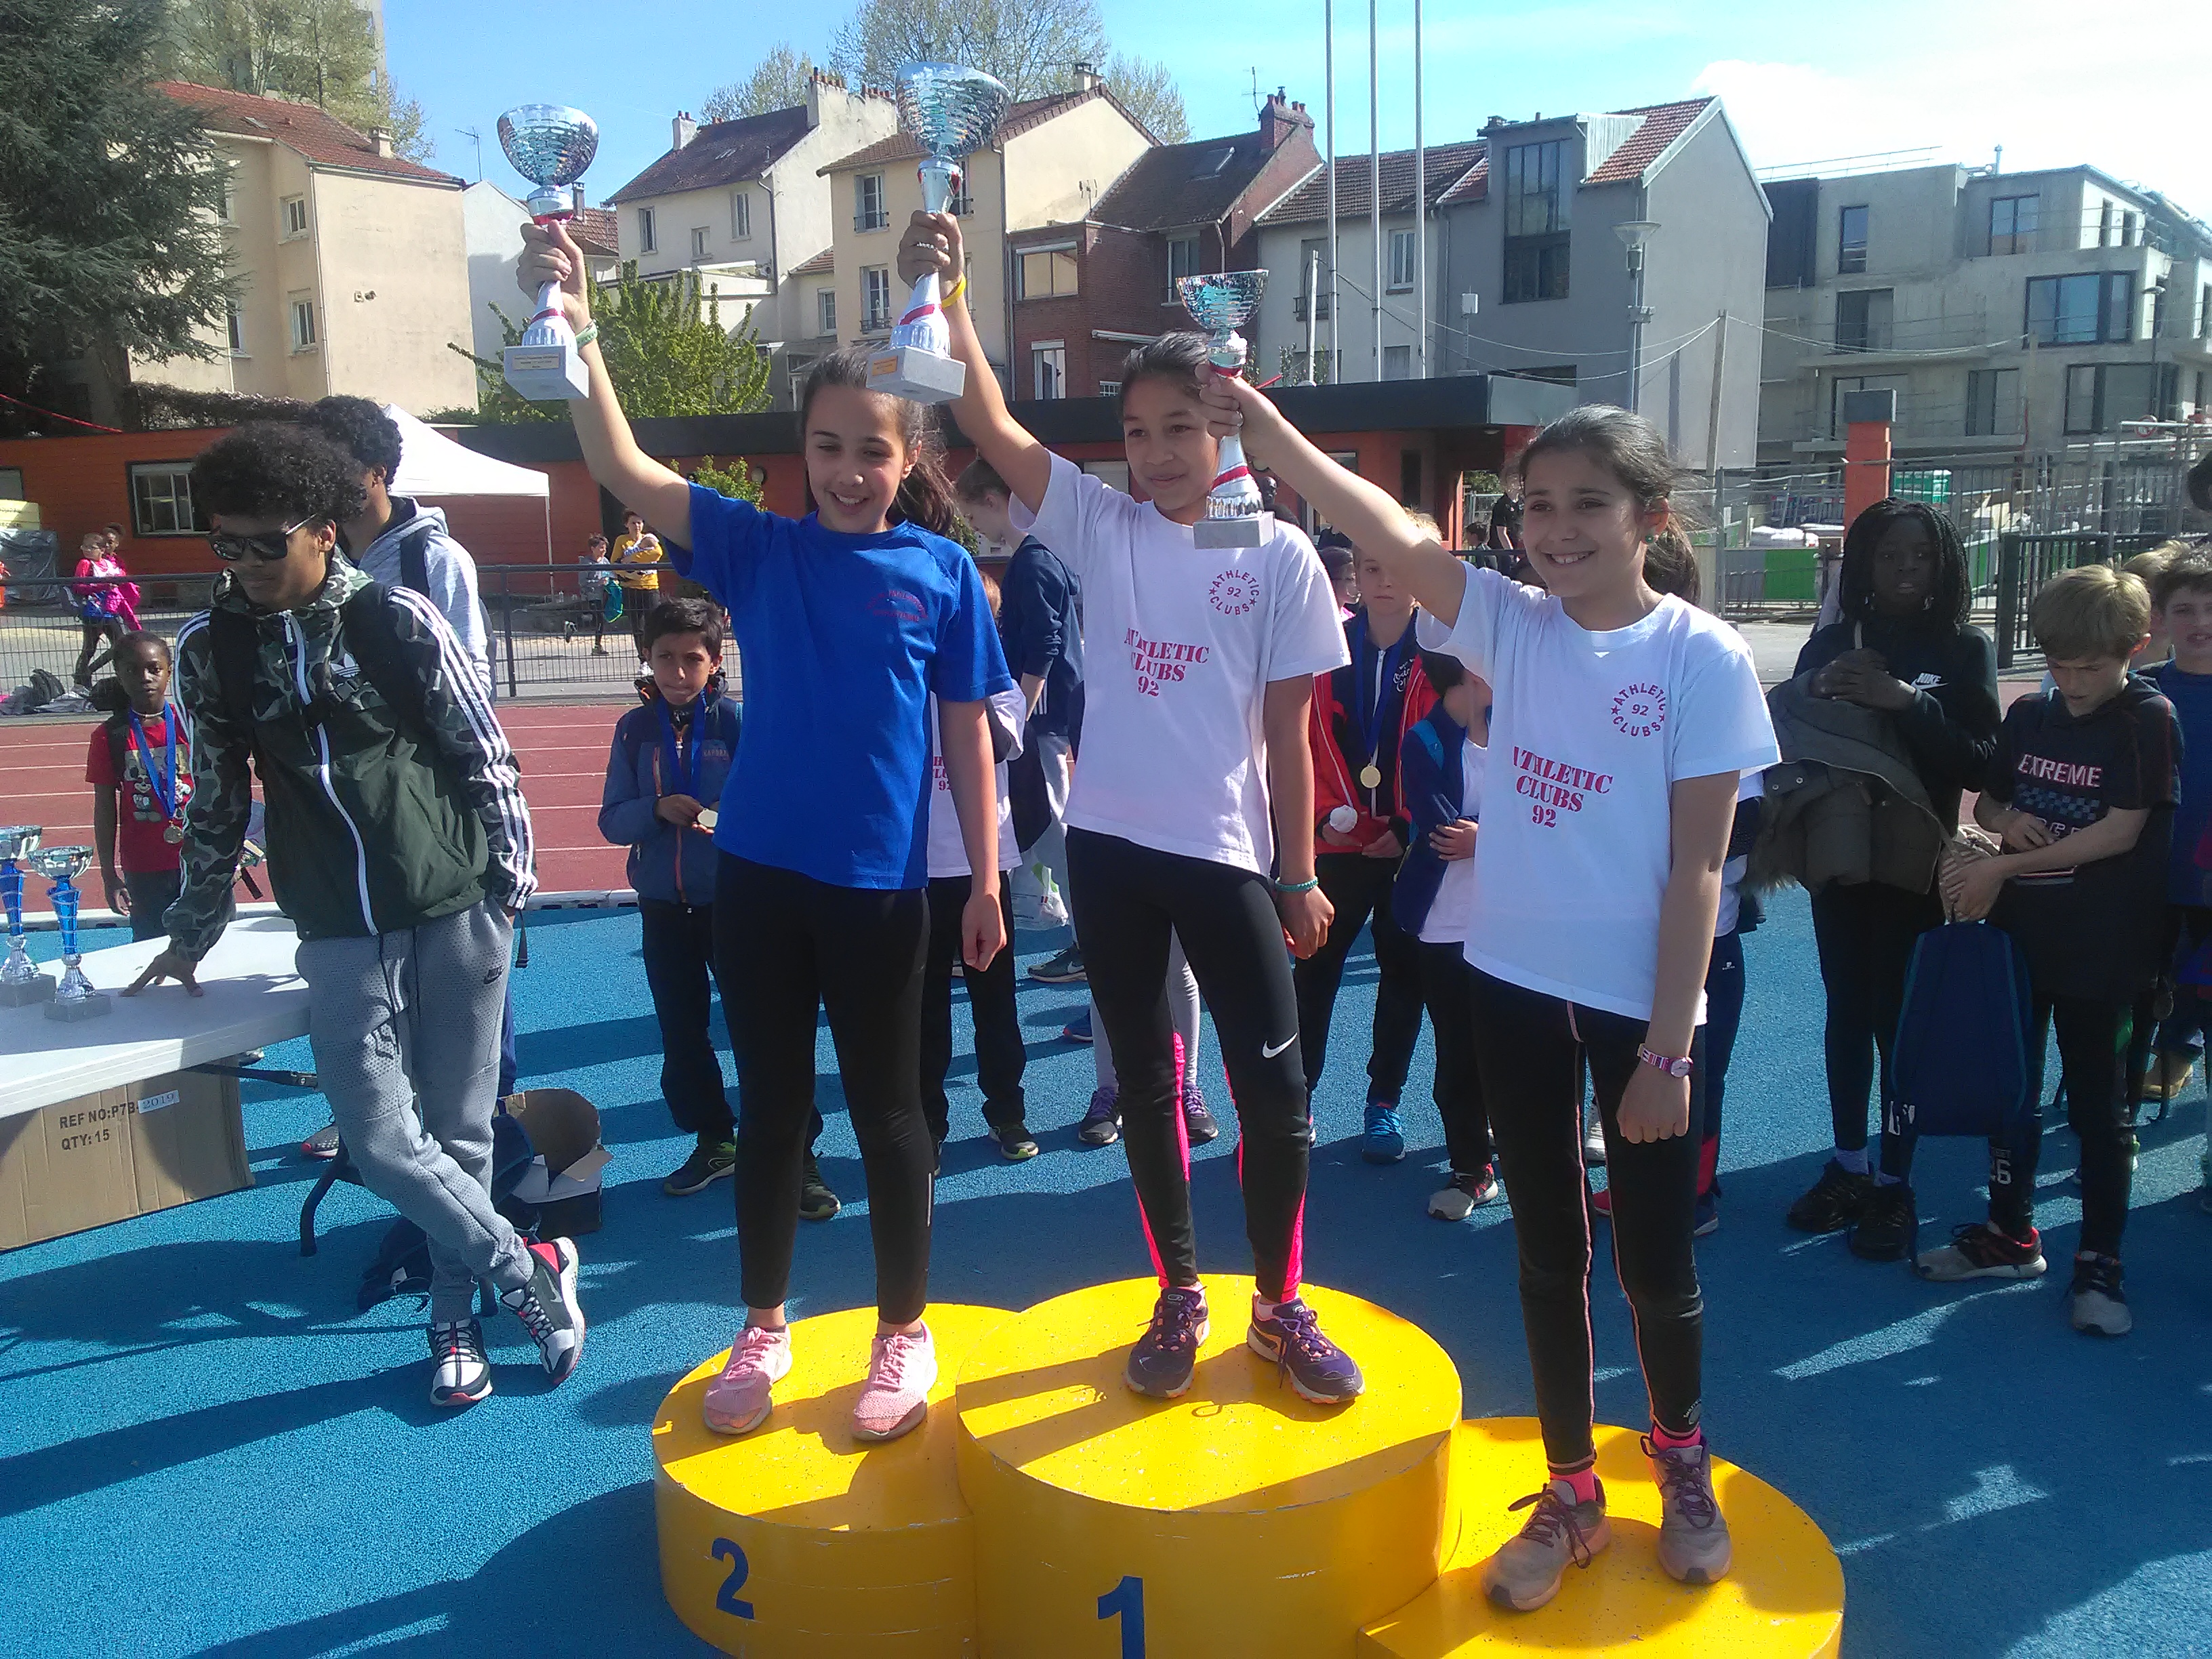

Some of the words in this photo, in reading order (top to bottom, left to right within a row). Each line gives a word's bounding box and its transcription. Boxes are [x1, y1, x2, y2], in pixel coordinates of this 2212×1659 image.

[1212, 569, 1260, 596] ATHLETIC
[1226, 586, 1242, 598] 92
[1210, 596, 1250, 615] CLUBS
[1137, 676, 1160, 697] 92
[1917, 672, 1942, 684] NIKE
[1613, 682, 1666, 711] ATHLETIC
[1631, 703, 1650, 716] 92
[1613, 716, 1662, 737] CLUBS
[1516, 775, 1584, 812] CLUBS
[1532, 804, 1557, 827] 92
[142, 1093, 175, 1109] 2019
[59, 1114, 84, 1129] REF
[61, 1134, 92, 1151] QTY:
[94, 1128, 110, 1143] 15
[711, 1536, 755, 1620] 2
[1097, 1576, 1146, 1659] 1
